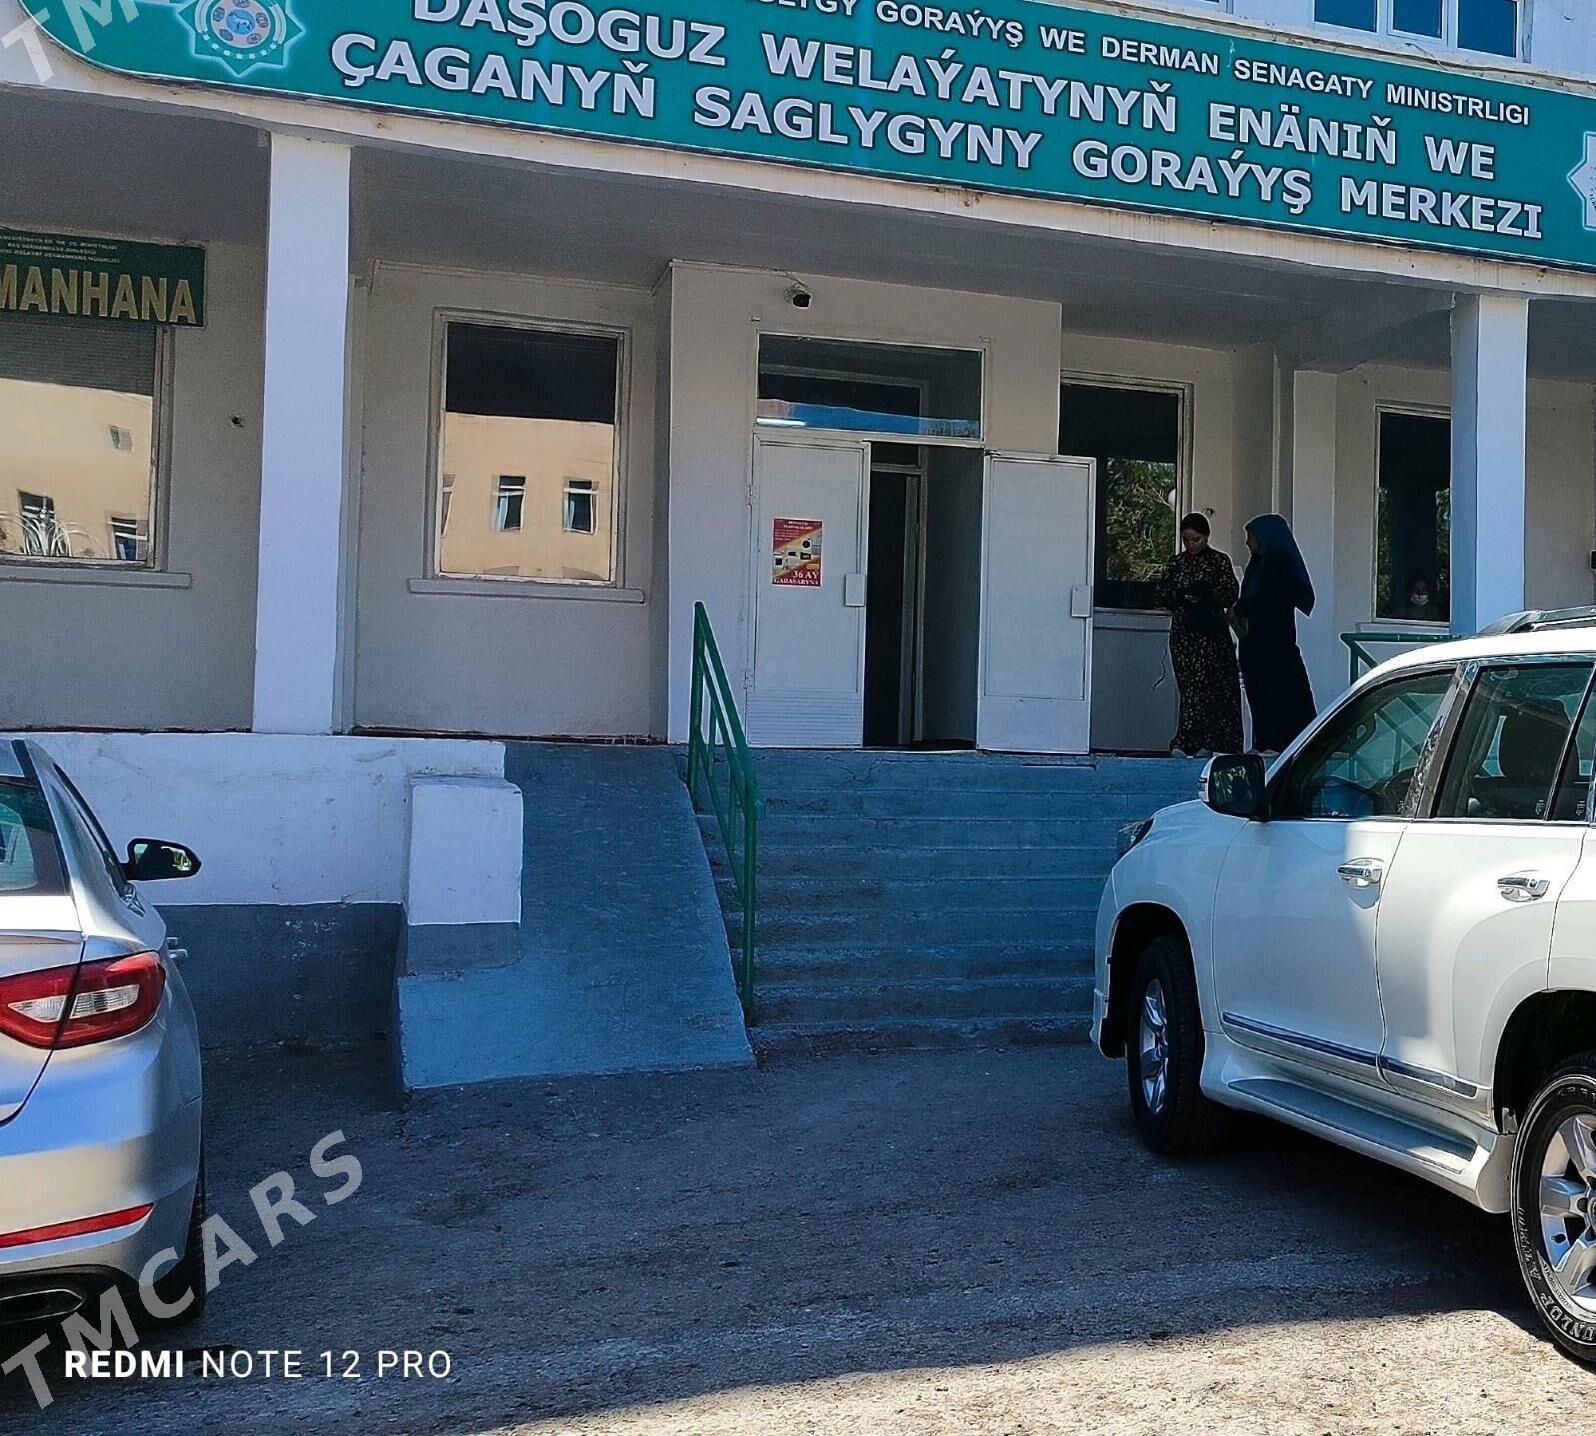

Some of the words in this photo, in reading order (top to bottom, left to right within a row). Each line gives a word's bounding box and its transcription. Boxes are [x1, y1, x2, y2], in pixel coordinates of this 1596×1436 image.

[331, 33, 655, 118] ÇAGANYŇ
[694, 86, 1042, 169] SAGLYGYNY
[1072, 140, 1312, 214] GORAÝYŞ
[1340, 177, 1542, 239] MERKEZI
[761, 32, 1176, 132] WELAÝATYNYŇ
[1209, 102, 1396, 164] ENÄNIŇ
[1425, 136, 1496, 180] WE
[876, 0, 1024, 48] GORAÝYŞ
[1040, 26, 1086, 54] WE
[1102, 37, 1218, 75] DERMAN
[1234, 59, 1374, 99] SENAGATY
[1387, 84, 1530, 126] MINISTRLIGI
